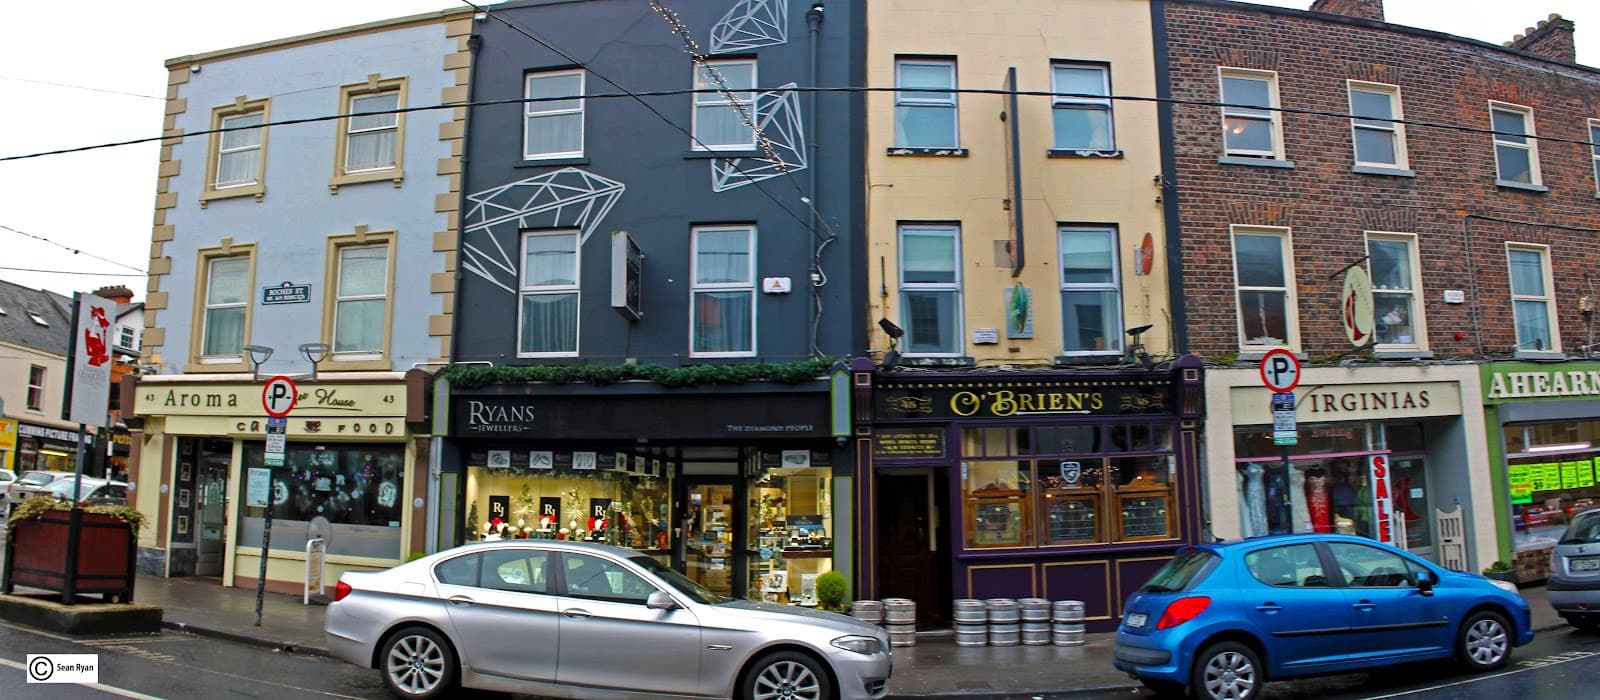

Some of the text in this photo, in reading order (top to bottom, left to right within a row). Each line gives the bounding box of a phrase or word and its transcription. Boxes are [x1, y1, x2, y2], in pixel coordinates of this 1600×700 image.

[1272, 357, 1289, 386] P
[164, 389, 238, 407] Aroma
[271, 383, 287, 410] P
[315, 389, 356, 407] House
[383, 394, 395, 403] 43
[950, 390, 1104, 416] O'BRIEN'S
[468, 401, 535, 424] RYANS
[338, 423, 393, 434] FOOD
[478, 424, 522, 432] JEWELLERS
[1372, 456, 1391, 543] SALE
